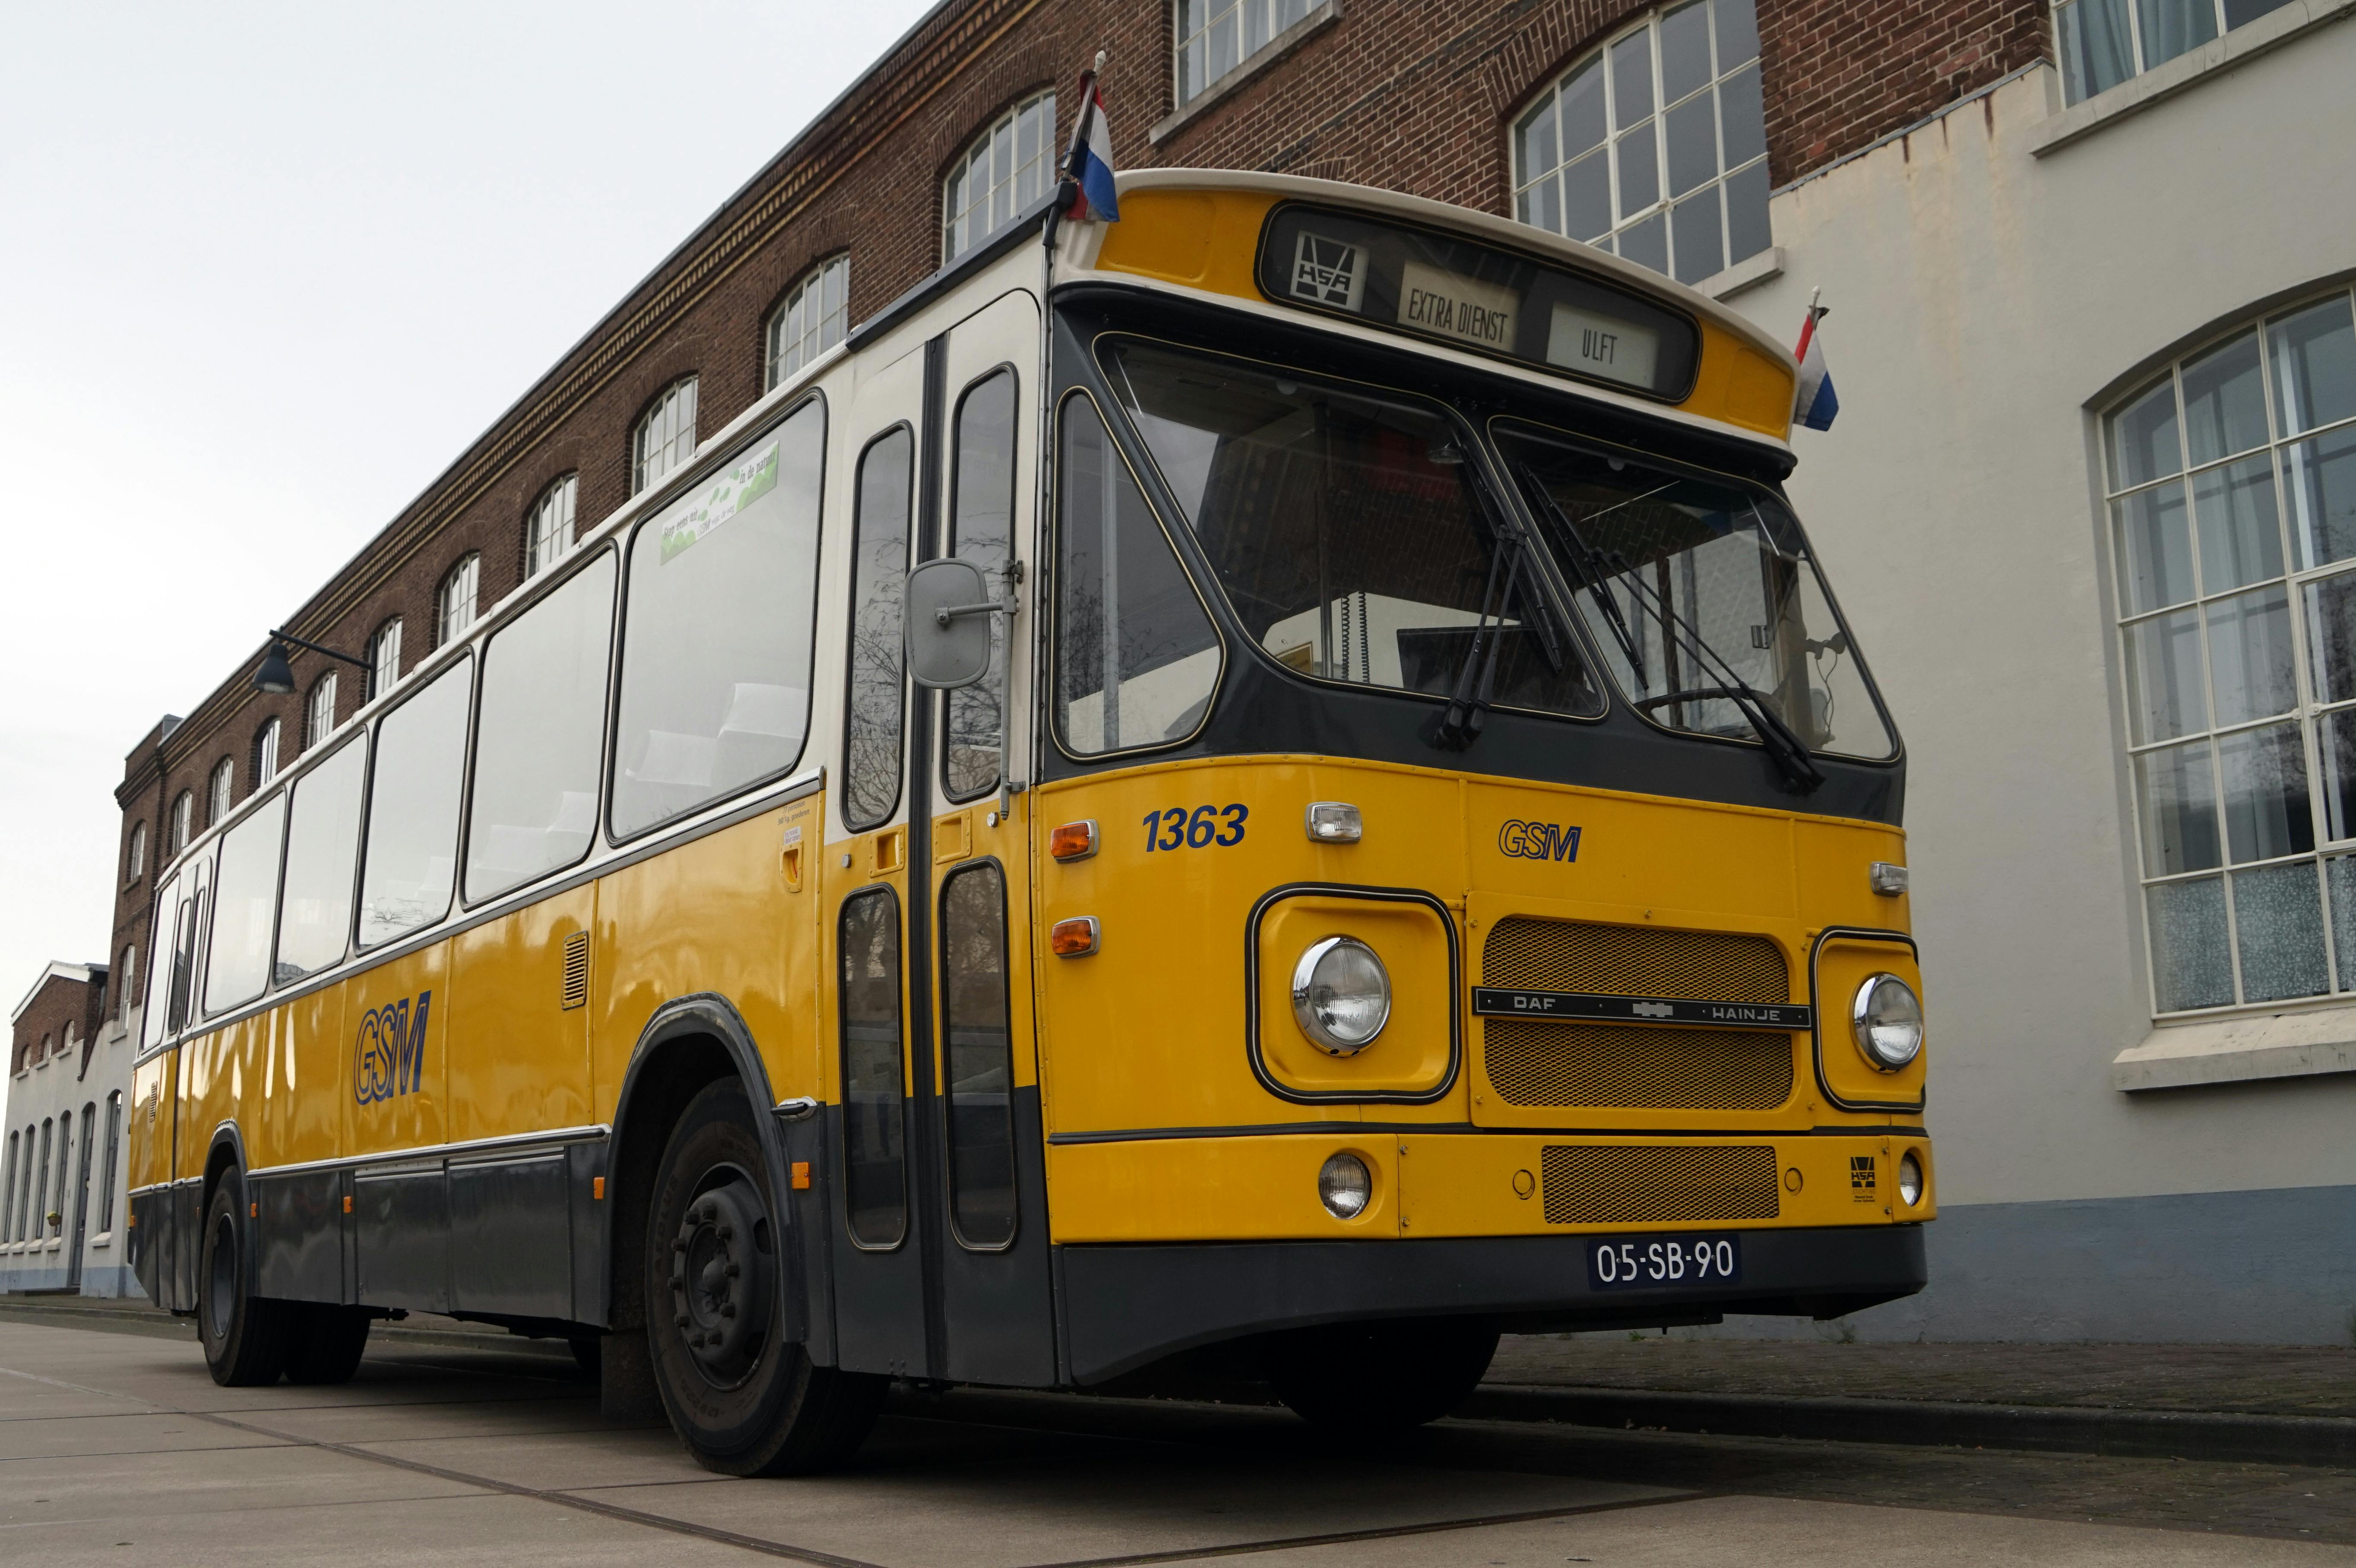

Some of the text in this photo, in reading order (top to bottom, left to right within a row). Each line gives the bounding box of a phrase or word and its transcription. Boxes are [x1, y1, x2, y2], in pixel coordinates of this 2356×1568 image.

[1298, 263, 1351, 292] HSA
[1408, 288, 1508, 343] EXTRA DIENST
[1582, 328, 1618, 364] ULFT
[739, 451, 776, 484] in de natuur
[676, 515, 688, 531] eens
[697, 518, 711, 537] GSM
[788, 801, 805, 814] personen
[791, 809, 810, 822] goederen
[789, 827, 798, 836] nood
[1143, 803, 1249, 853] 1363
[1498, 819, 1582, 863] GSM
[1513, 996, 1781, 1021] DAF HAINJE
[353, 989, 432, 1105] GSM
[1851, 1171, 1875, 1180] HSA
[1597, 1240, 1733, 1283] 05-SB-90
